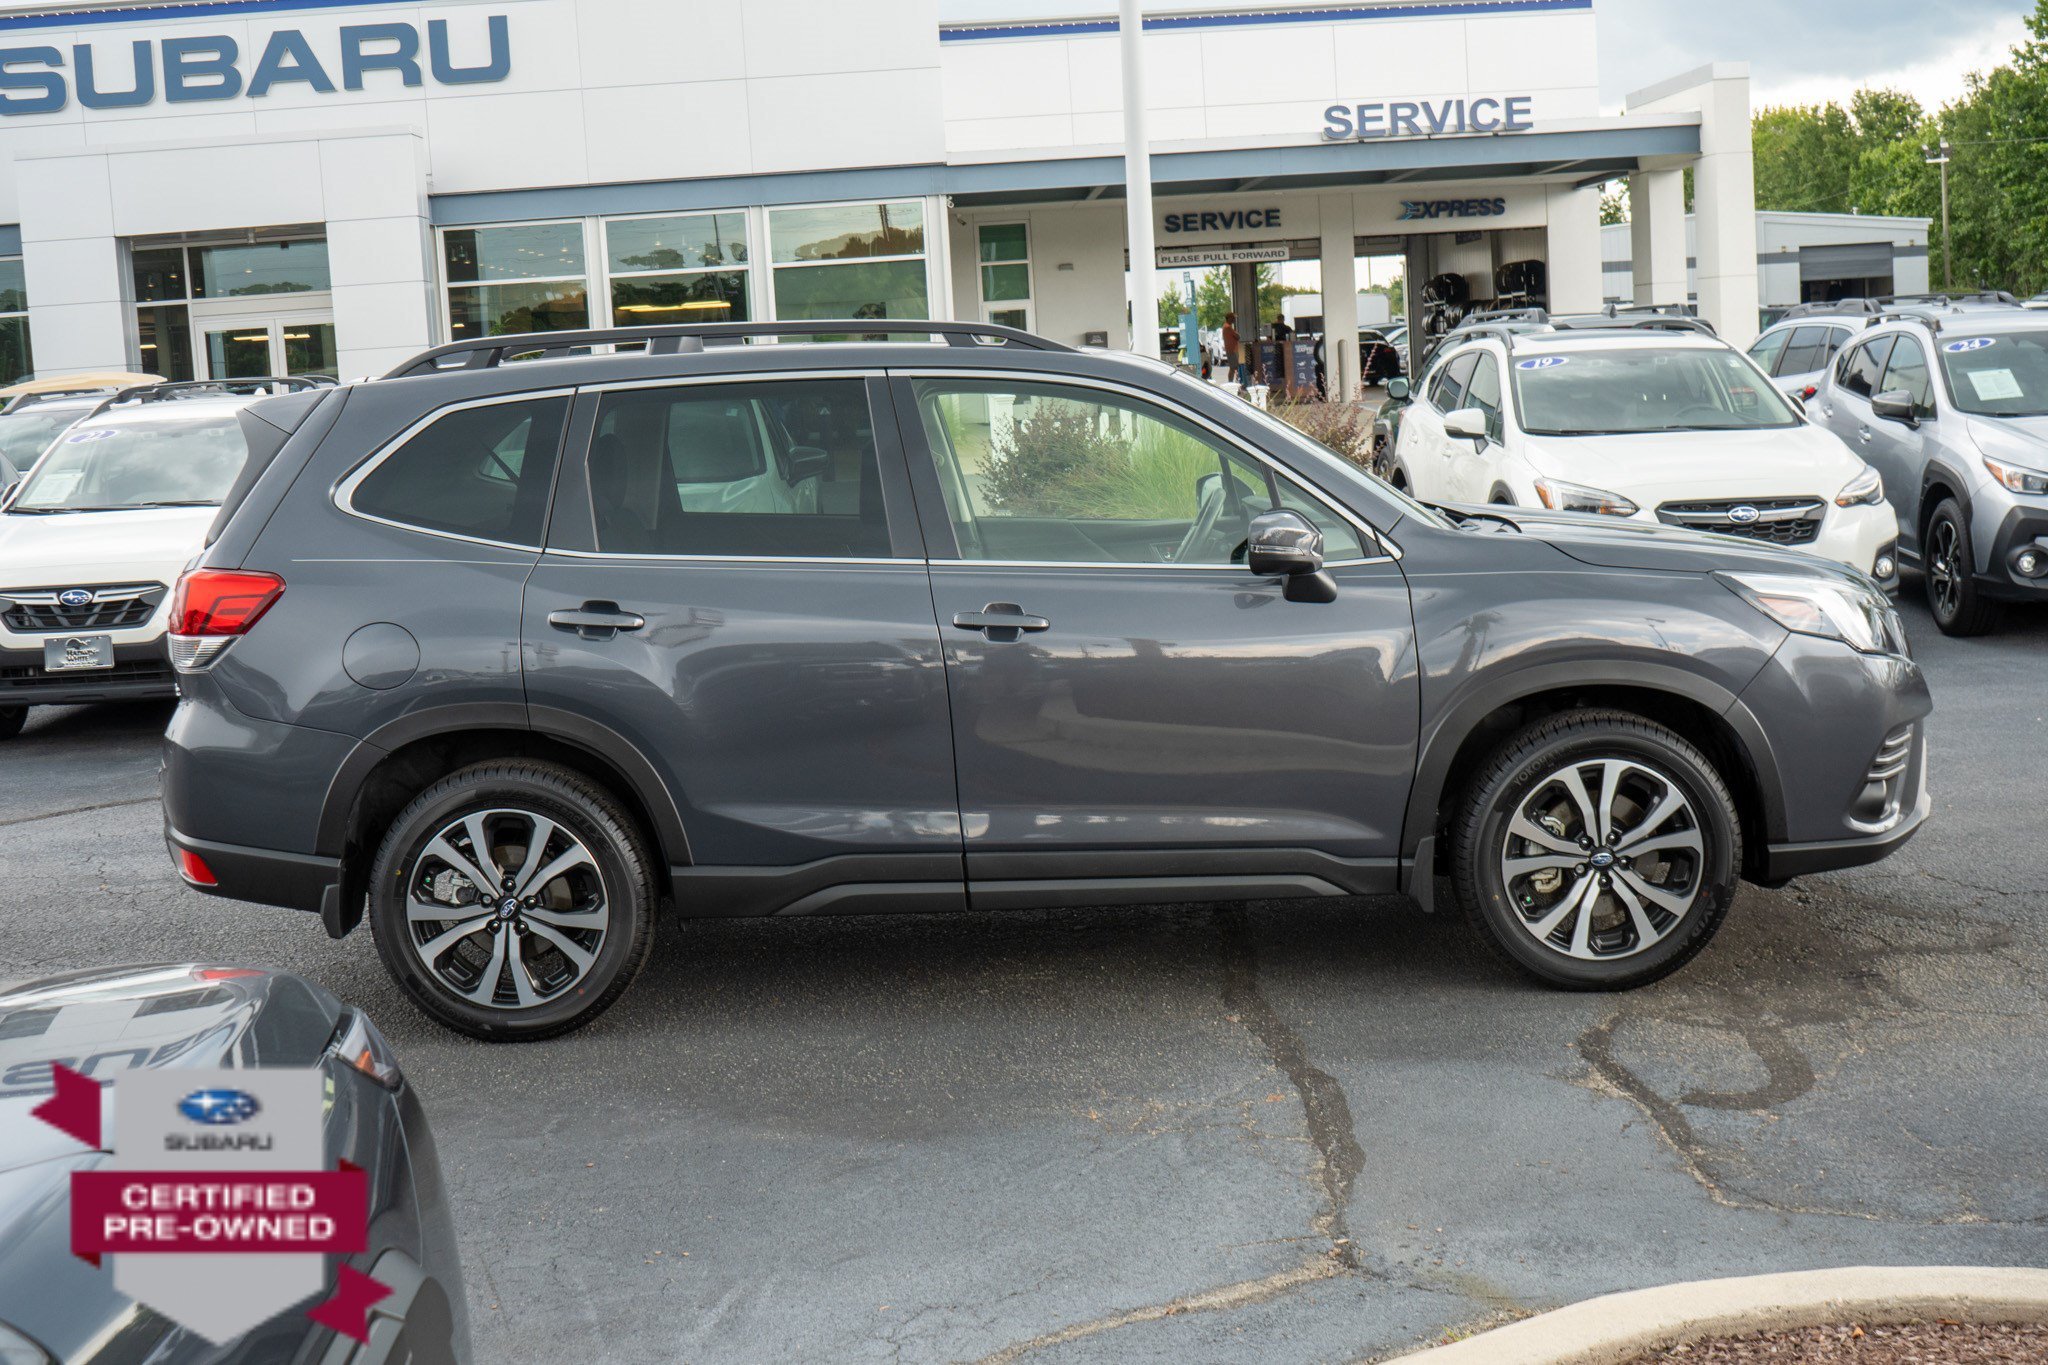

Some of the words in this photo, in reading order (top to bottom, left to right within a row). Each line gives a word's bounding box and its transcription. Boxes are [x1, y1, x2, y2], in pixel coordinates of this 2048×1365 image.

[0, 15, 511, 116] SUBARU
[1323, 97, 1534, 139] SERVICE
[1397, 197, 1506, 220] EXPRESS
[1164, 208, 1282, 233] SERVICE
[1161, 254, 1201, 265] PLEASE
[1203, 252, 1230, 263] PULL
[1232, 250, 1286, 261] FORWARD
[1960, 338, 1981, 351] 24
[1534, 357, 1554, 369] 19
